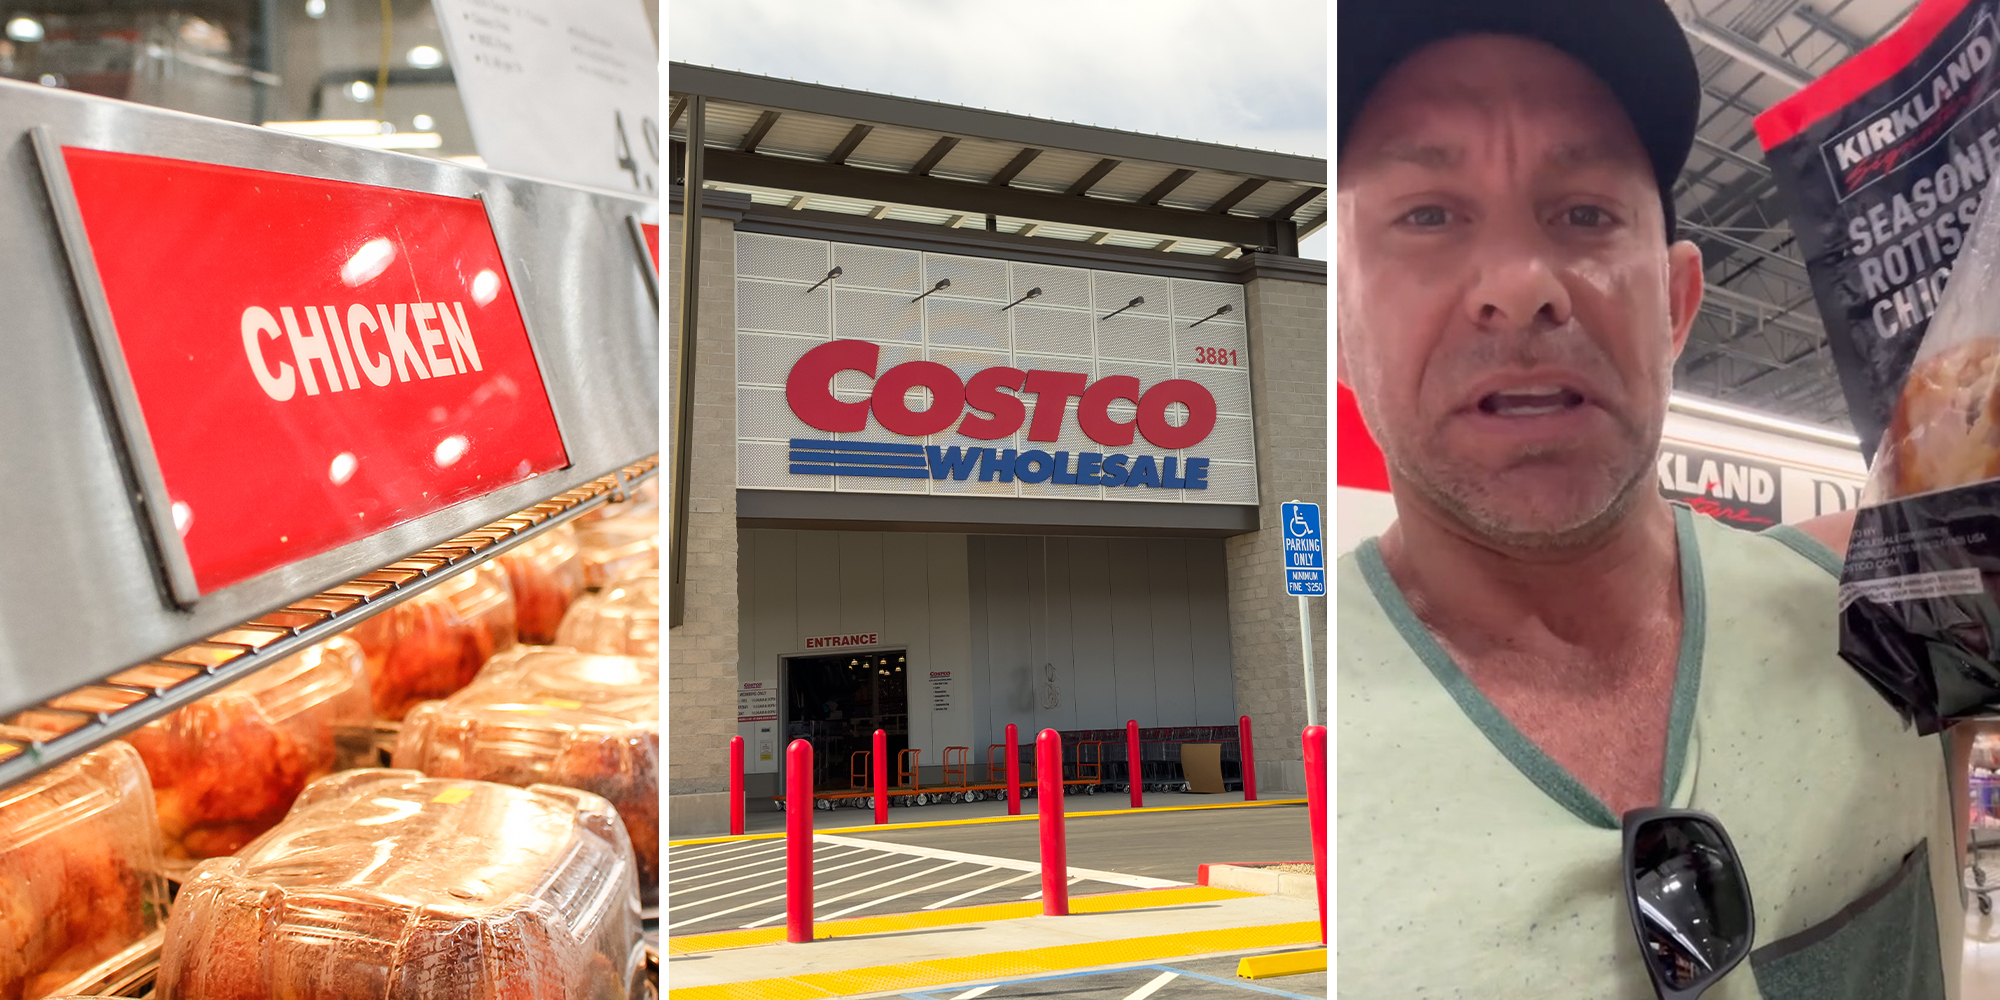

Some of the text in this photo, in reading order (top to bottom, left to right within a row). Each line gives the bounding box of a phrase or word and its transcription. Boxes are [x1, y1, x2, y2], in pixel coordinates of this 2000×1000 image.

[1834, 35, 1991, 171] KIRKLAND
[1848, 122, 2000, 256] SEASONE
[241, 301, 482, 402] CHICKEN
[1195, 346, 1238, 366] 3881
[786, 339, 1217, 449] COSTCO
[924, 445, 1210, 490] WHOLESALE
[1286, 538, 1320, 552] PARKING
[1293, 552, 1314, 566] ONLY
[1292, 571, 1318, 581] MINIMUM
[1289, 582, 1303, 592] FINE
[806, 634, 878, 649] ENTRANCE
